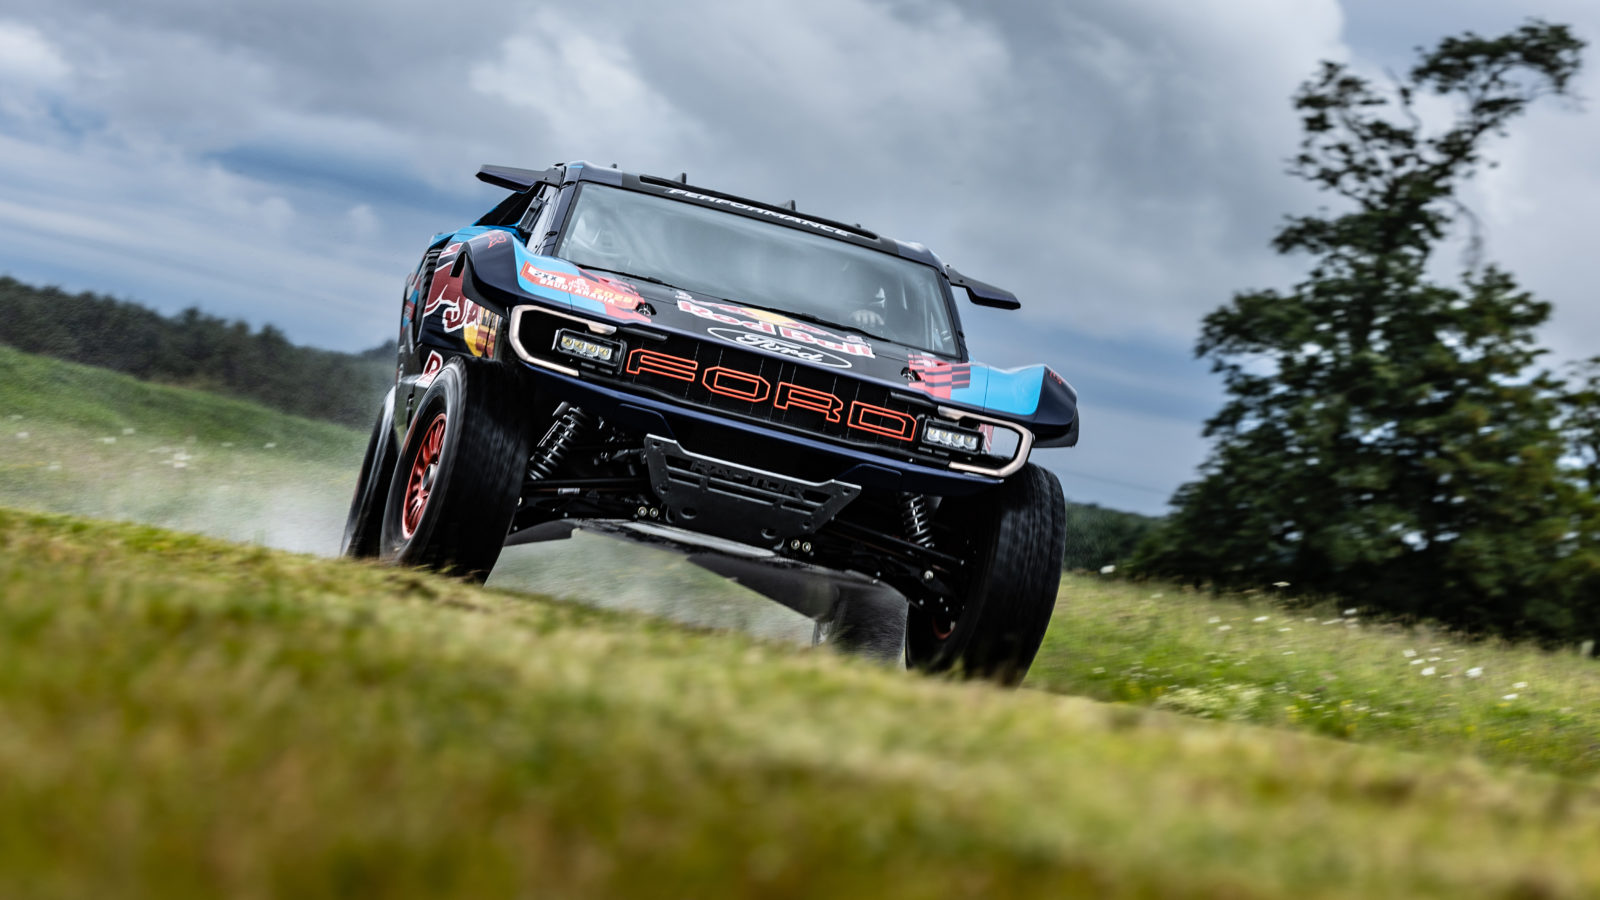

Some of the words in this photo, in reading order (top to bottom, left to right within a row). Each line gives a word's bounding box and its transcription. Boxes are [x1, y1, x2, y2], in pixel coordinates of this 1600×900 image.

[668, 187, 849, 237] PERFORMANCE
[539, 278, 573, 292] SAUDI
[575, 287, 615, 304] ARABIA
[676, 299, 777, 336] Red
[778, 325, 876, 359] Bull
[735, 333, 824, 363] Ford
[626, 348, 918, 441] FORD
[690, 461, 805, 501] RAPTOR
